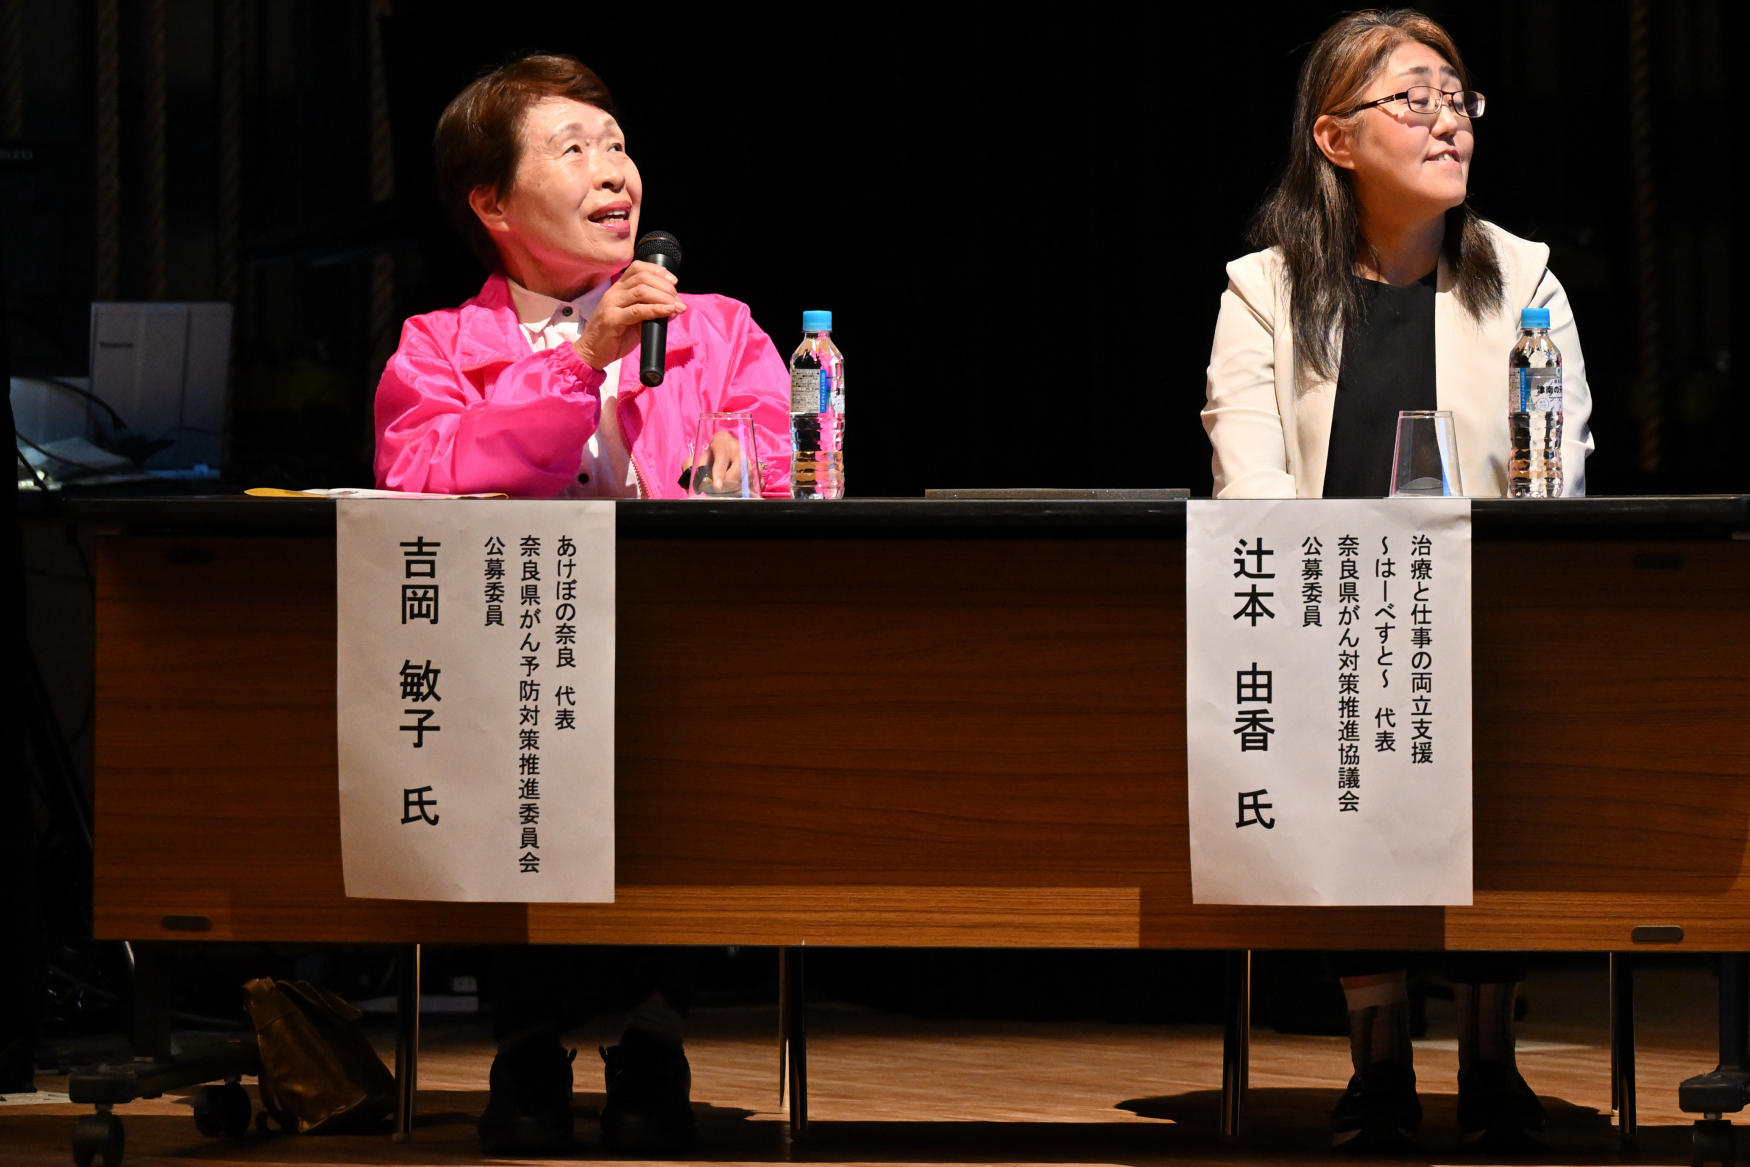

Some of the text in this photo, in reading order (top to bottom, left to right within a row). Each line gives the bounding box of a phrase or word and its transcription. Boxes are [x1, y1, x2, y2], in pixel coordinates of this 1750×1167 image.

[399, 536, 442, 826] 吉岡 敏子 氏
[484, 537, 505, 626] 公募委員
[555, 535, 577, 730] あけぼの奈良 代表
[1233, 538, 1275, 829] 辻本 由香 氏
[1302, 537, 1323, 627] 公募委員
[1338, 534, 1360, 812] 奈良県がん対策推進協議会
[1411, 535, 1433, 763] 治療と仕事の両立支援
[519, 535, 541, 873] 奈良県がん予防対策推進委員会
[1375, 708, 1396, 752] 代表
